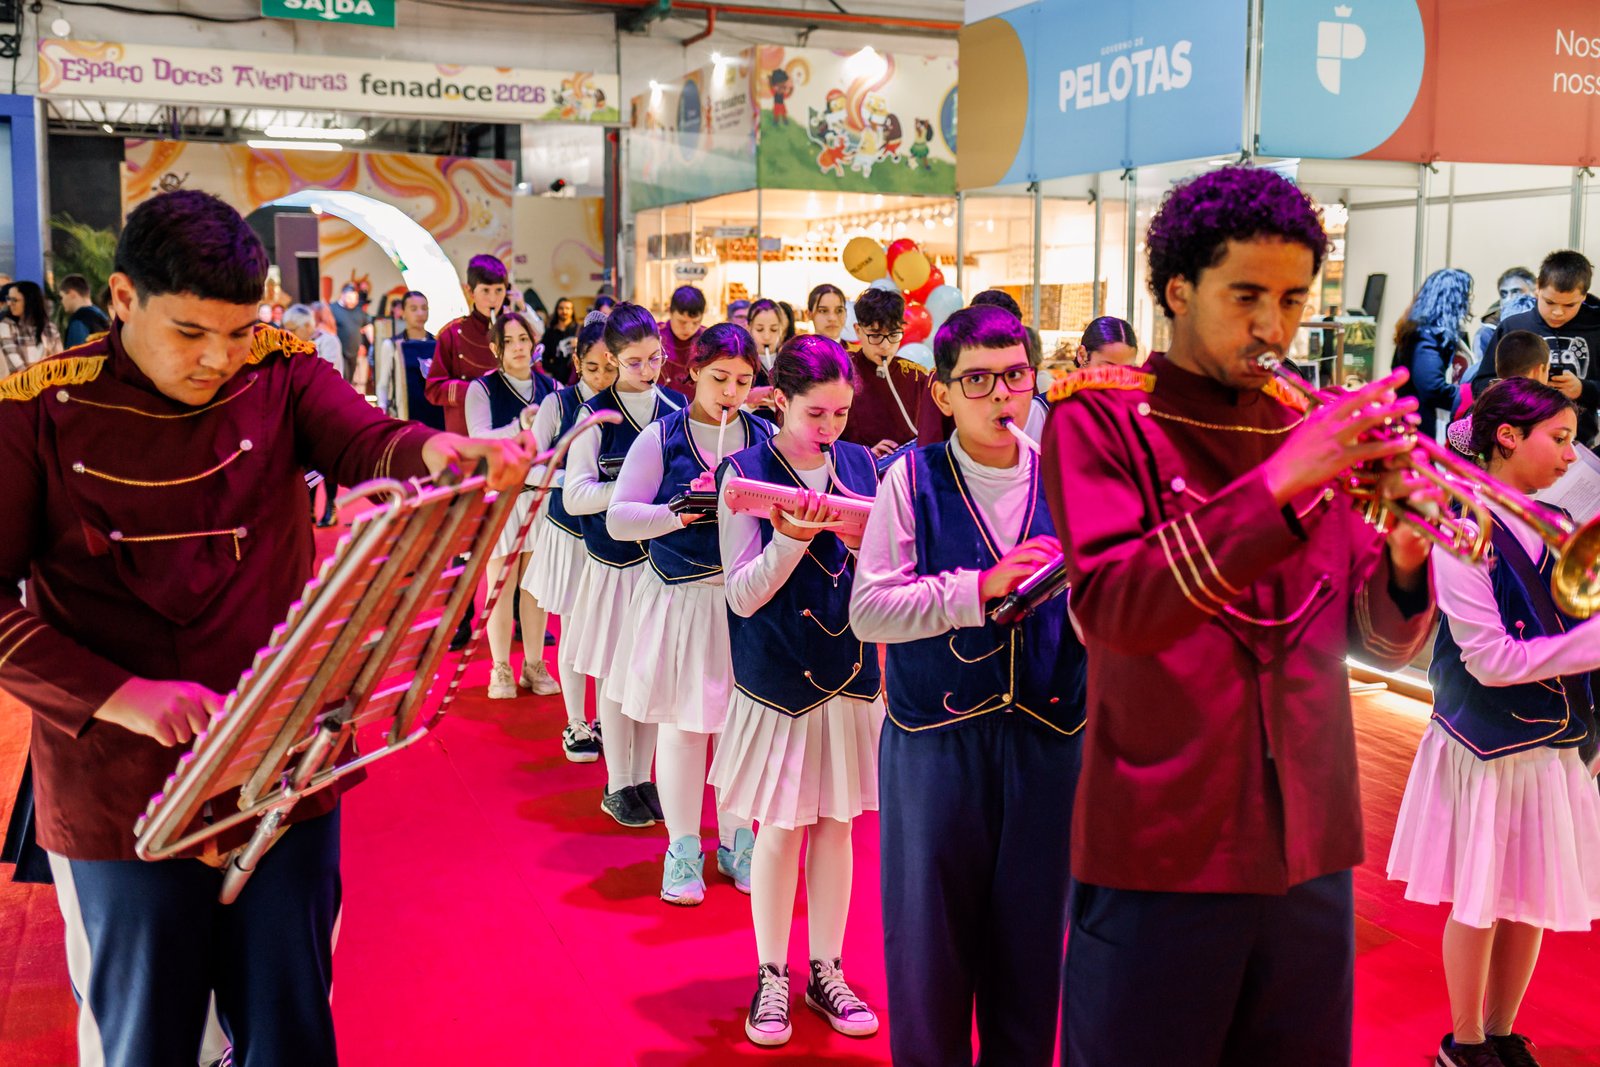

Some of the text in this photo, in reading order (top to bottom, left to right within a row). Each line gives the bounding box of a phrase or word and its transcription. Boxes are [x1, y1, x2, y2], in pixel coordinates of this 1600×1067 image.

[60, 58, 546, 104] Espaço Doces Aventuras fenadoce 2026
[1059, 39, 1192, 113] PELOTAS
[676, 266, 705, 275] CAIXA
